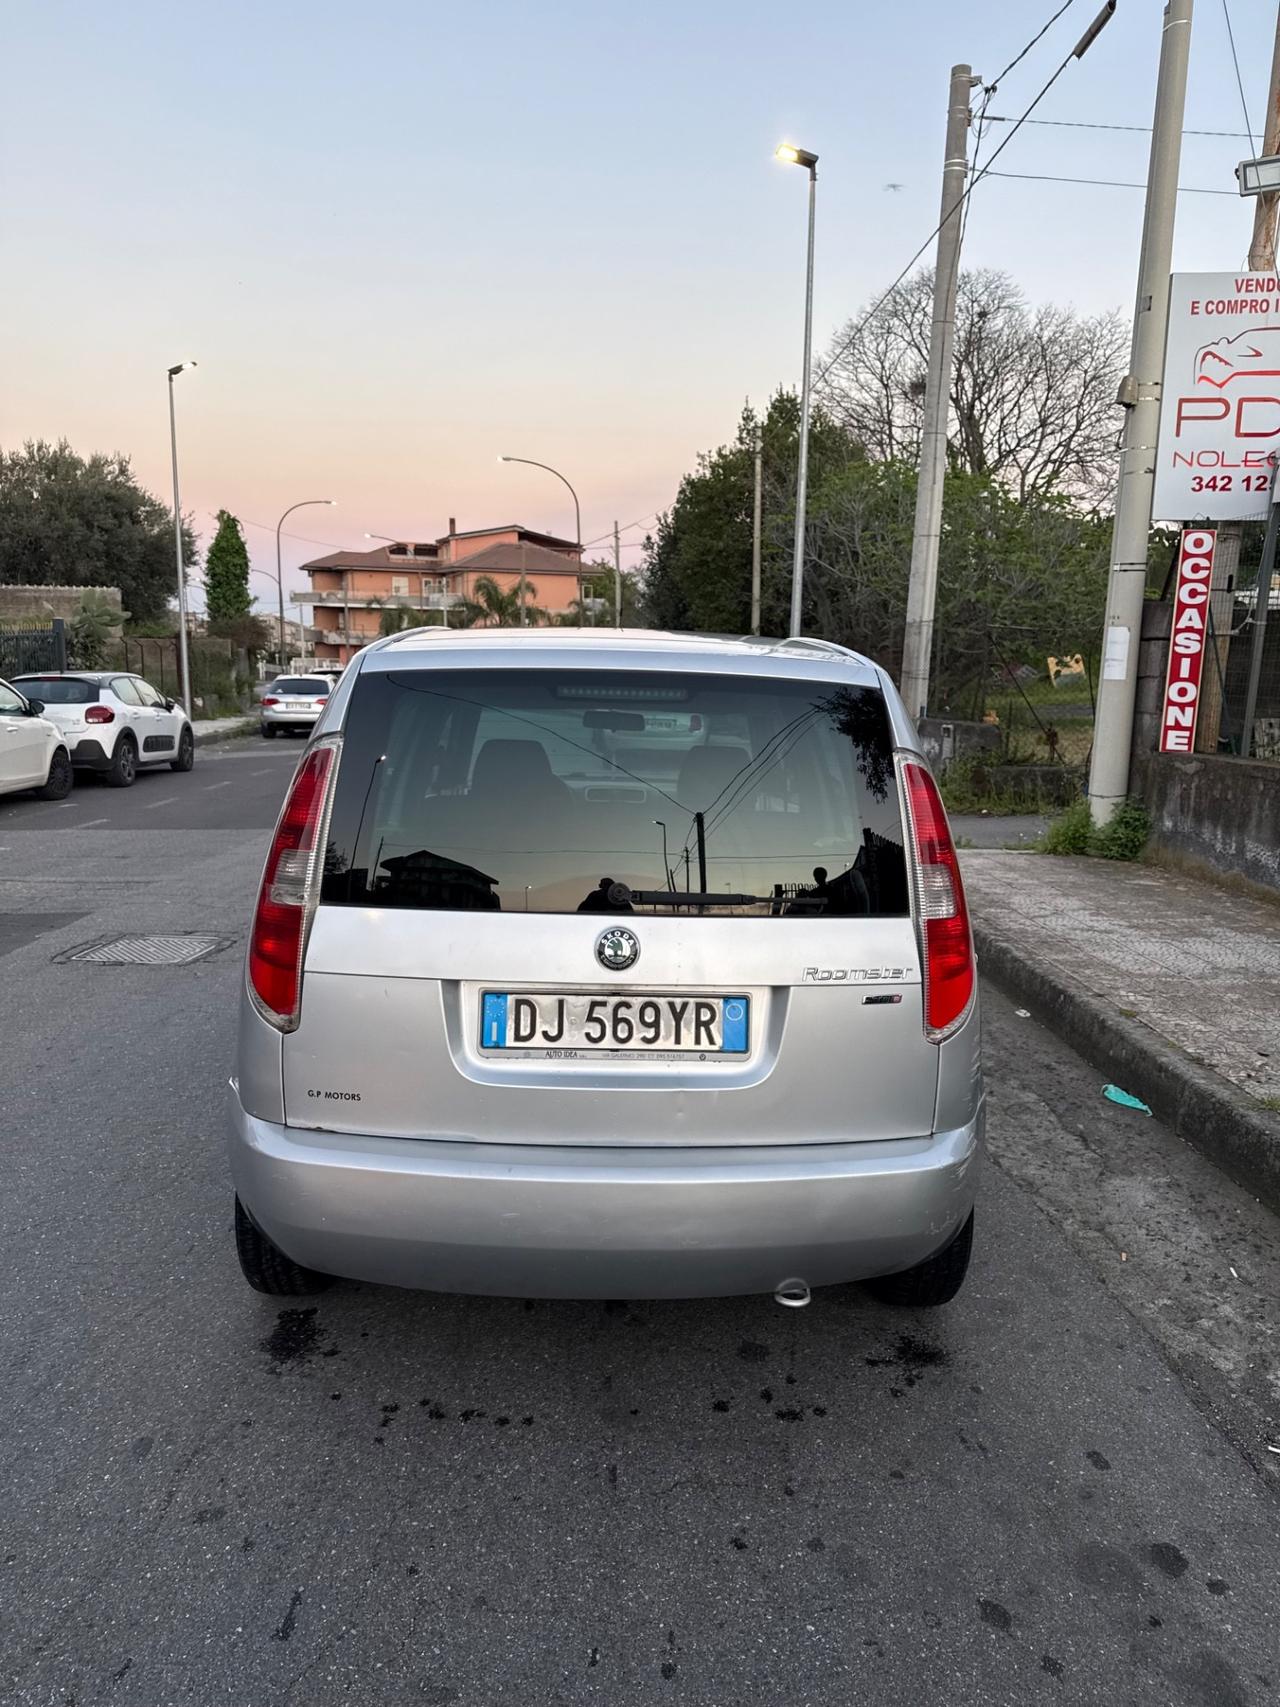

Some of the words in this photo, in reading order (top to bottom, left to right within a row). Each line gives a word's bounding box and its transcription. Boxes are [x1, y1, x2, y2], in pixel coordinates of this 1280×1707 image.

[1191, 300, 1200, 315] E
[1205, 299, 1270, 315] COMPRO
[1191, 476, 1233, 492] 342
[1241, 475, 1273, 492] 12
[1165, 532, 1214, 751] OCCASIONE
[802, 966, 913, 981] Roomster
[513, 998, 566, 1043] DJ
[584, 1000, 717, 1046] 569YR
[545, 1050, 563, 1059] AUTO
[324, 1091, 361, 1101] MOTORS
